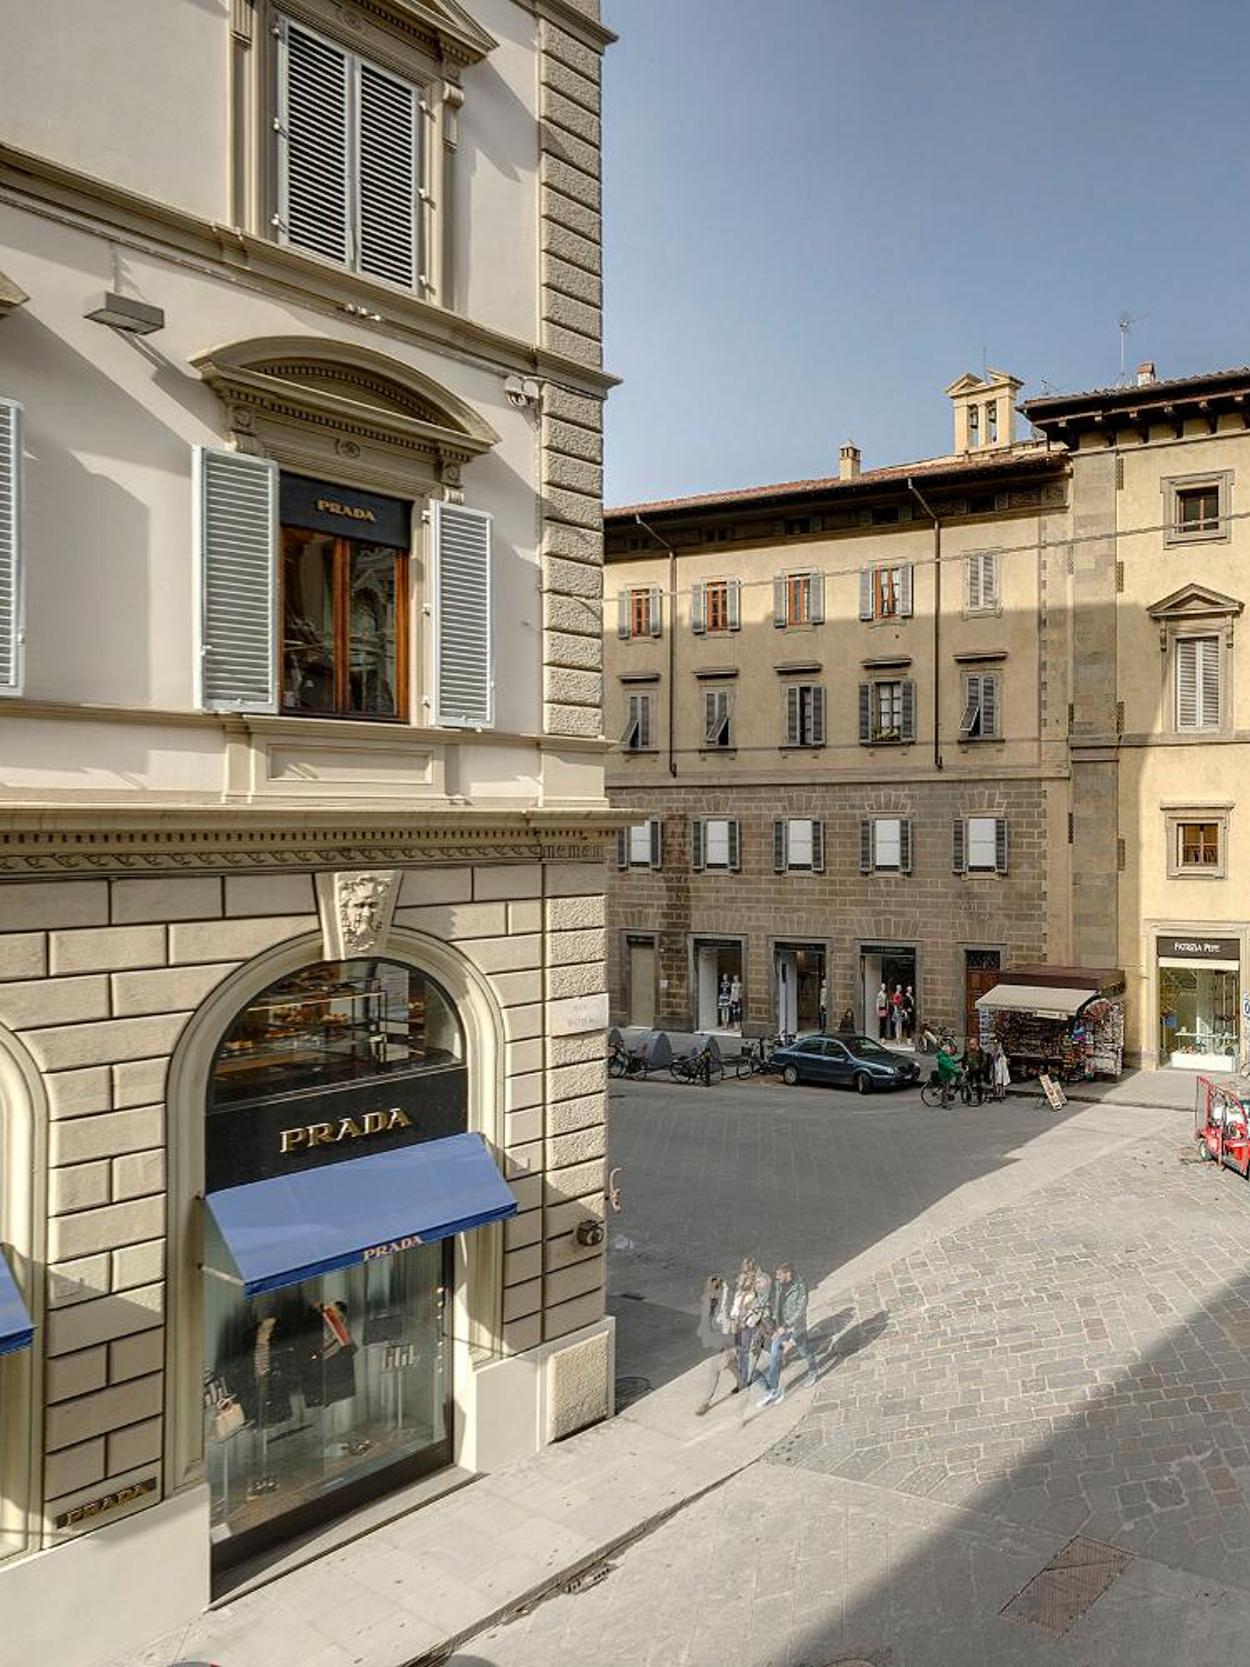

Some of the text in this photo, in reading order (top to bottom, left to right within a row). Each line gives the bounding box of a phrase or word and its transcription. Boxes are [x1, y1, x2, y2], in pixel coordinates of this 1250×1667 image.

[317, 500, 377, 522] PRADA
[279, 1107, 413, 1153] PRADA
[362, 1235, 424, 1262] PRADA
[66, 1483, 152, 1527] PRADA
